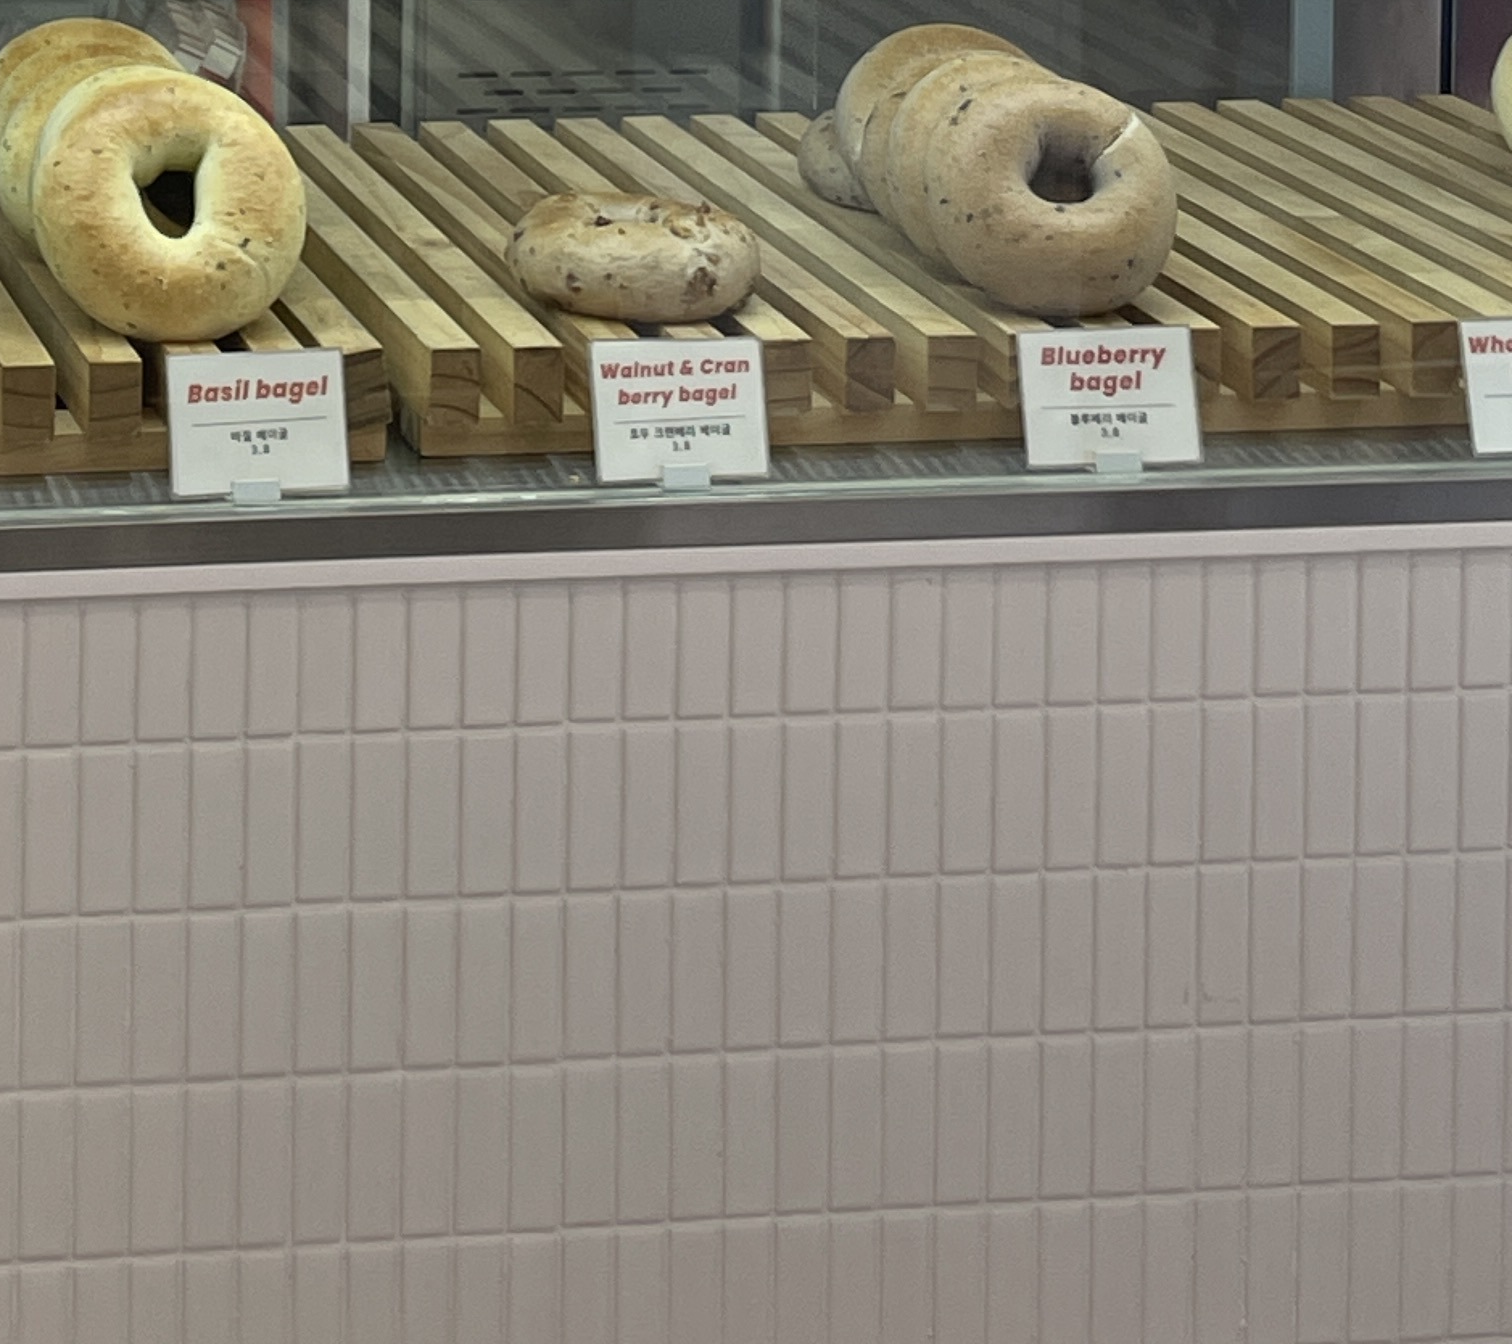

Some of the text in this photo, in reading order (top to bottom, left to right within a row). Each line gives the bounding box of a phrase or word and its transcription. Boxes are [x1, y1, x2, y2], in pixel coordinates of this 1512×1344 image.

[600, 359, 750, 379] Walnut & Cran
[1041, 345, 1166, 369] Blueberry
[188, 375, 328, 404] Basil bagel
[1070, 370, 1142, 397] bagel
[618, 384, 737, 408] berry bagel
